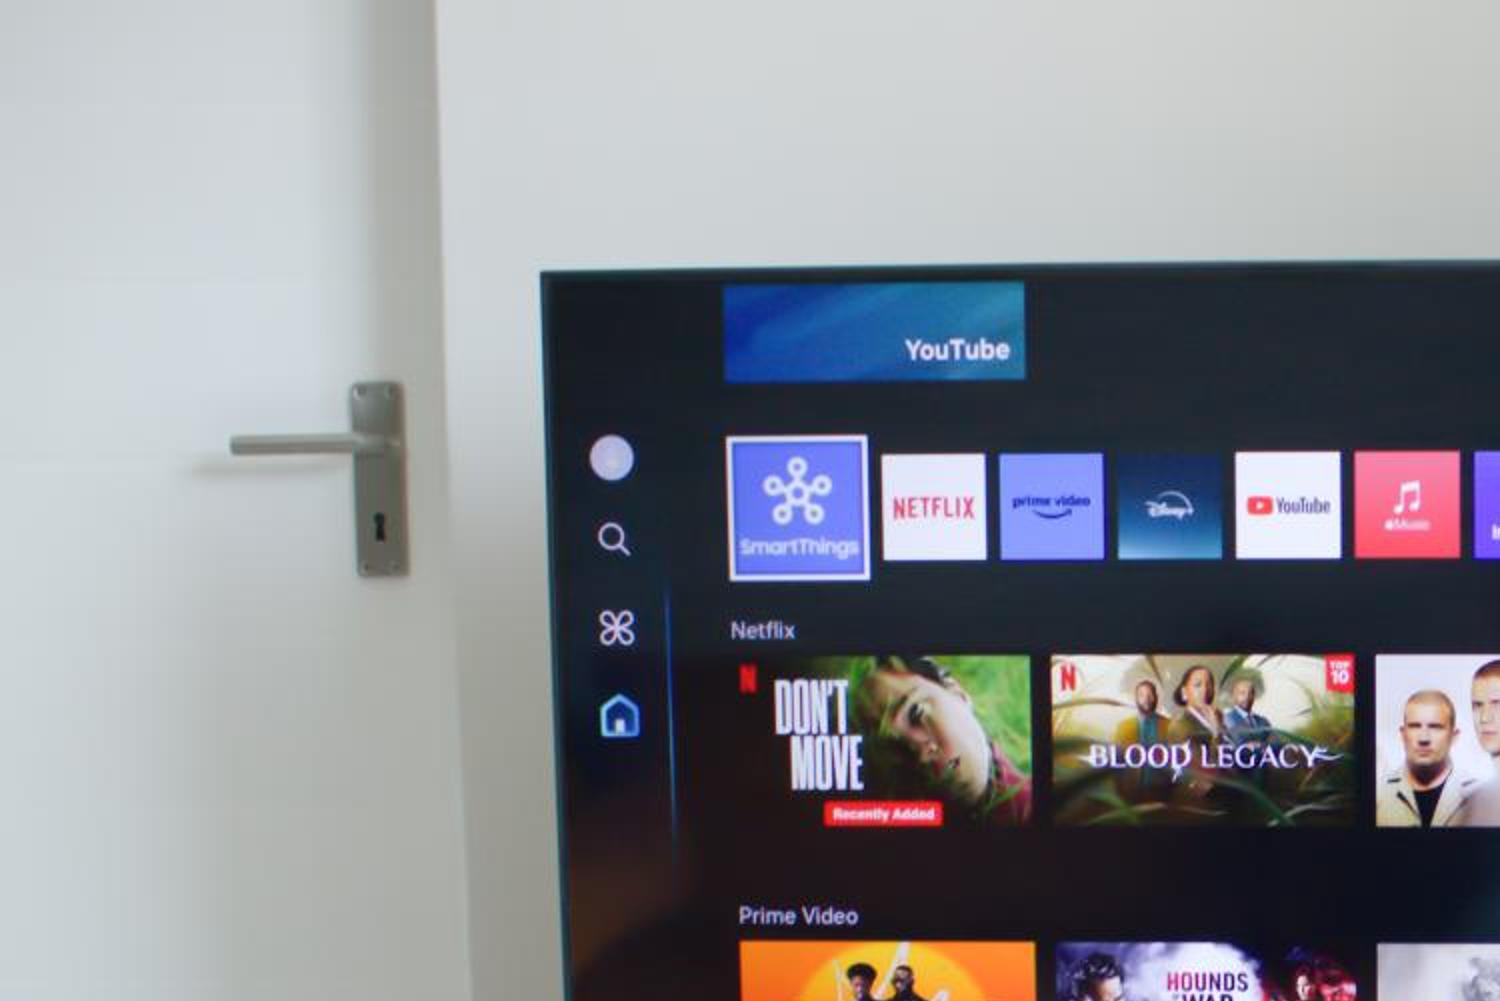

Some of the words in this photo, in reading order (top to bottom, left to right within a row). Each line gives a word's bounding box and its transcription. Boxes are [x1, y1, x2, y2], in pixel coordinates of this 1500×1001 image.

[904, 338, 1011, 361] YouTube
[892, 496, 976, 520] NETFLIX
[1011, 495, 1051, 509] prime
[1055, 493, 1092, 507] video
[1276, 495, 1332, 515] YouTube
[740, 538, 860, 559] SmartThings
[730, 621, 797, 640] Netflix
[1331, 671, 1349, 685] 10
[774, 679, 849, 735] DON'T
[790, 735, 864, 791] MOVE
[1082, 741, 1193, 776] BLOOD
[1200, 742, 1344, 769] LEGACY
[832, 806, 890, 823] Recently
[891, 806, 935, 821] Added
[739, 905, 797, 925] Prime
[801, 905, 859, 925] Video
[1167, 972, 1249, 992] HOUNDS
